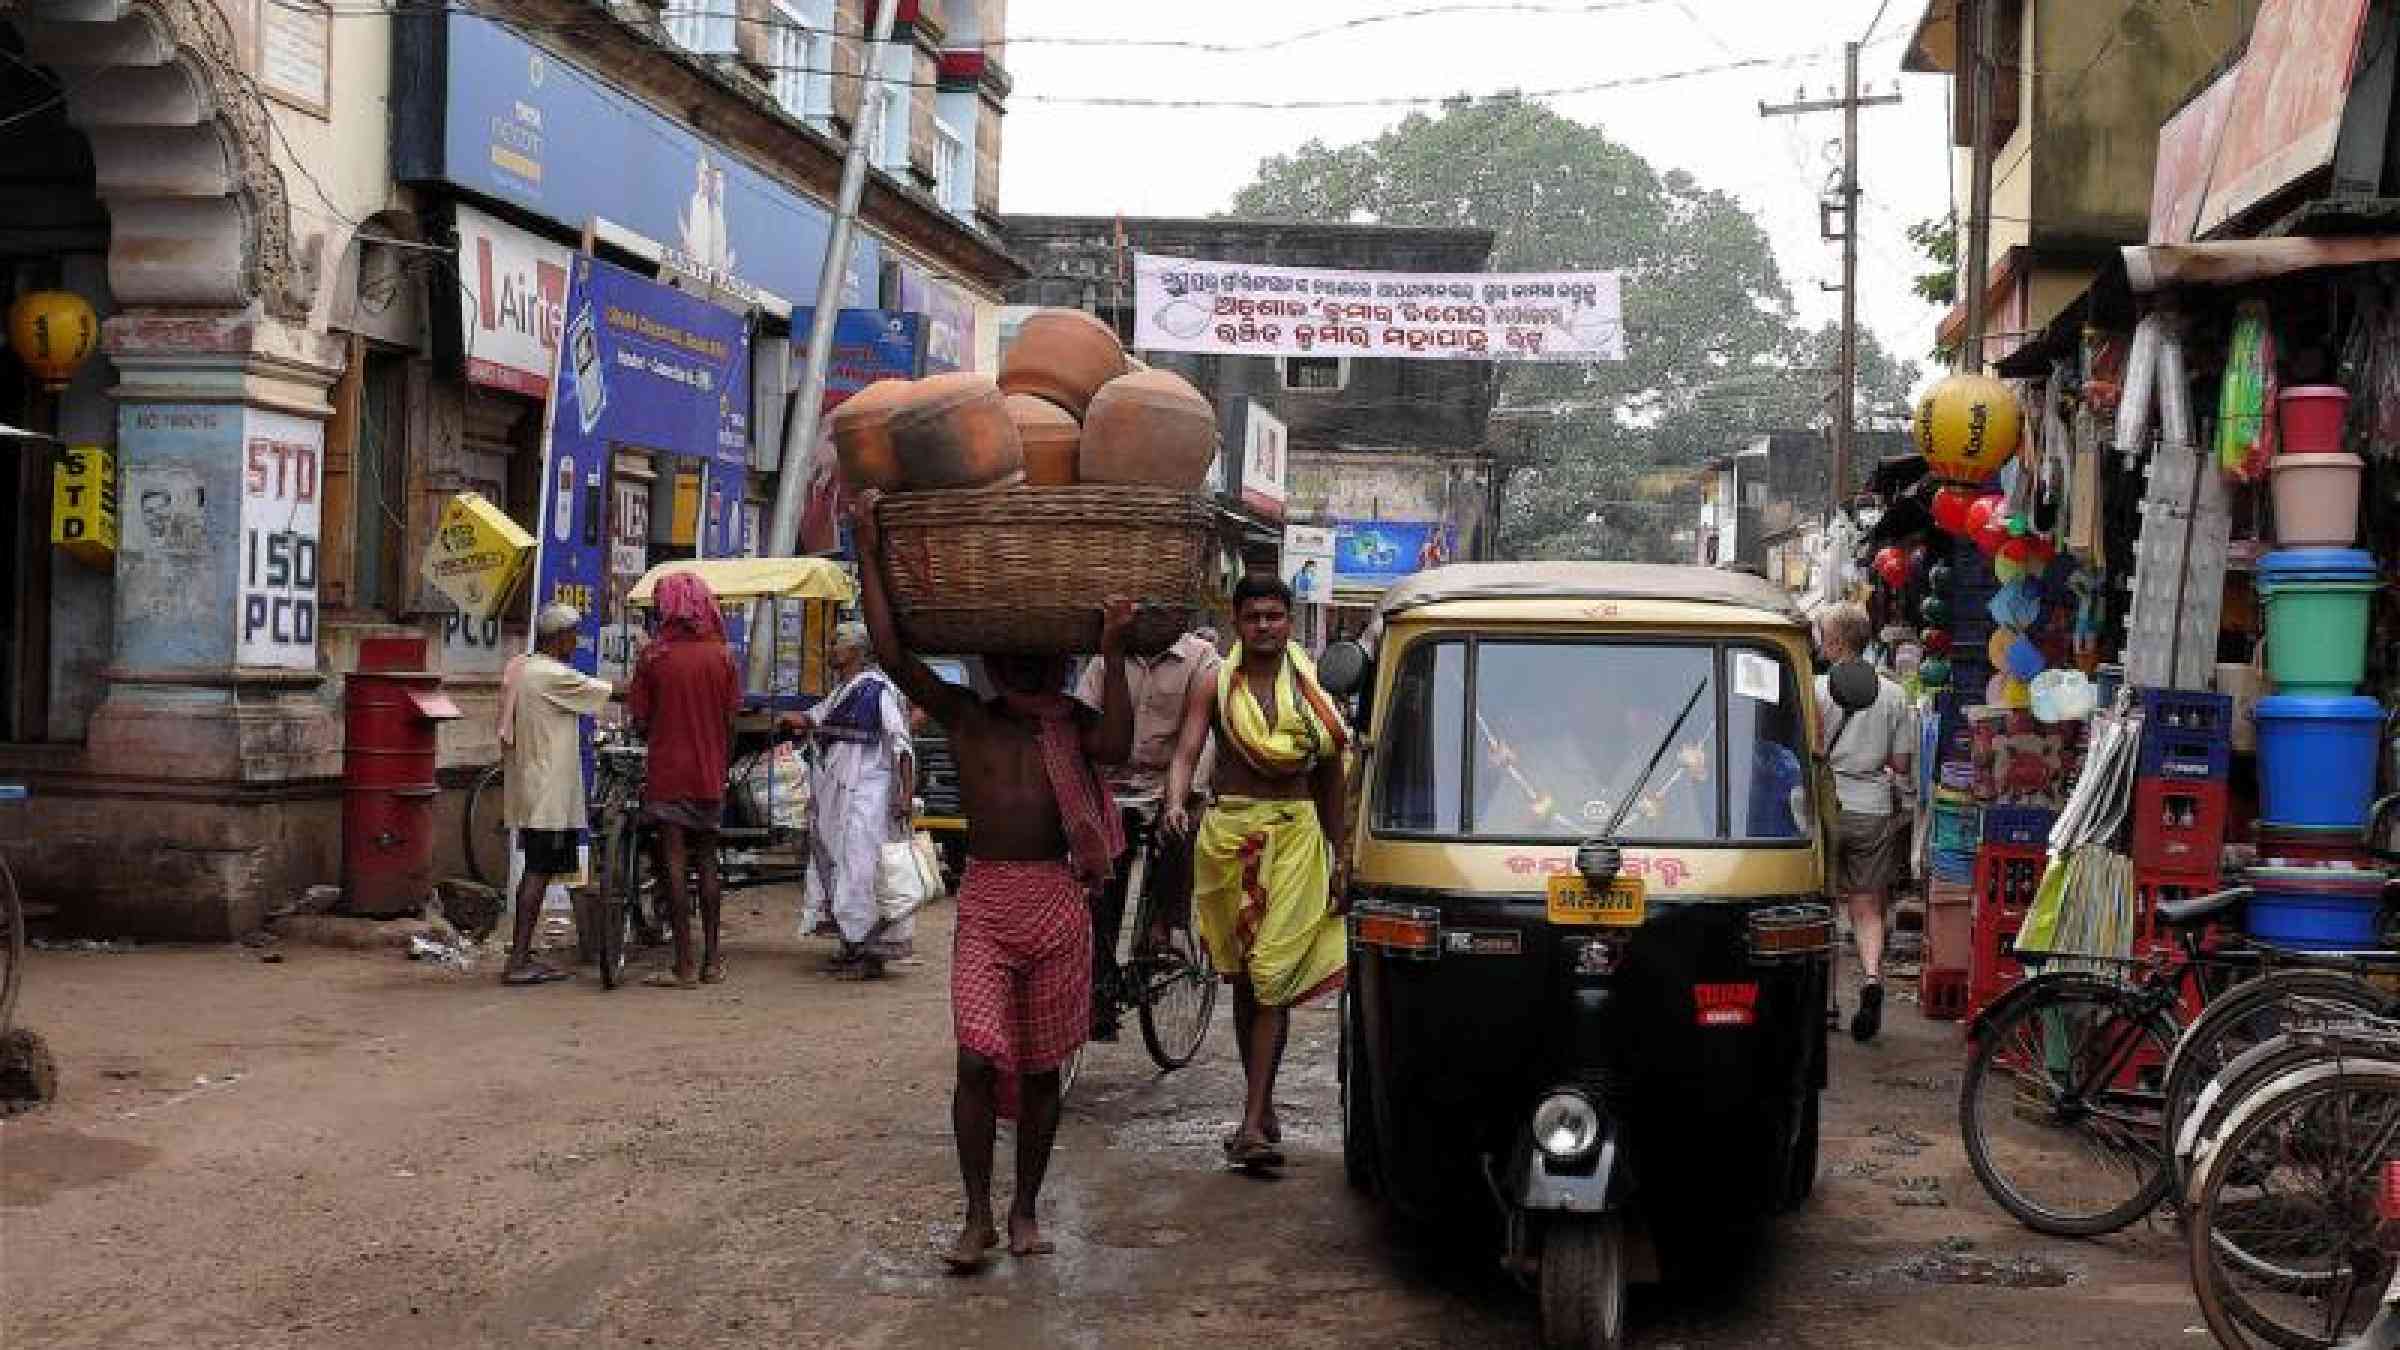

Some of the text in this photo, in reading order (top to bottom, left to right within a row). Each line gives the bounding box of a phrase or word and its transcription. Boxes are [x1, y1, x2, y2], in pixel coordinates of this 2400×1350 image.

[498, 268, 563, 349] Airte
[246, 436, 316, 503] STD
[244, 593, 314, 646] PCO
